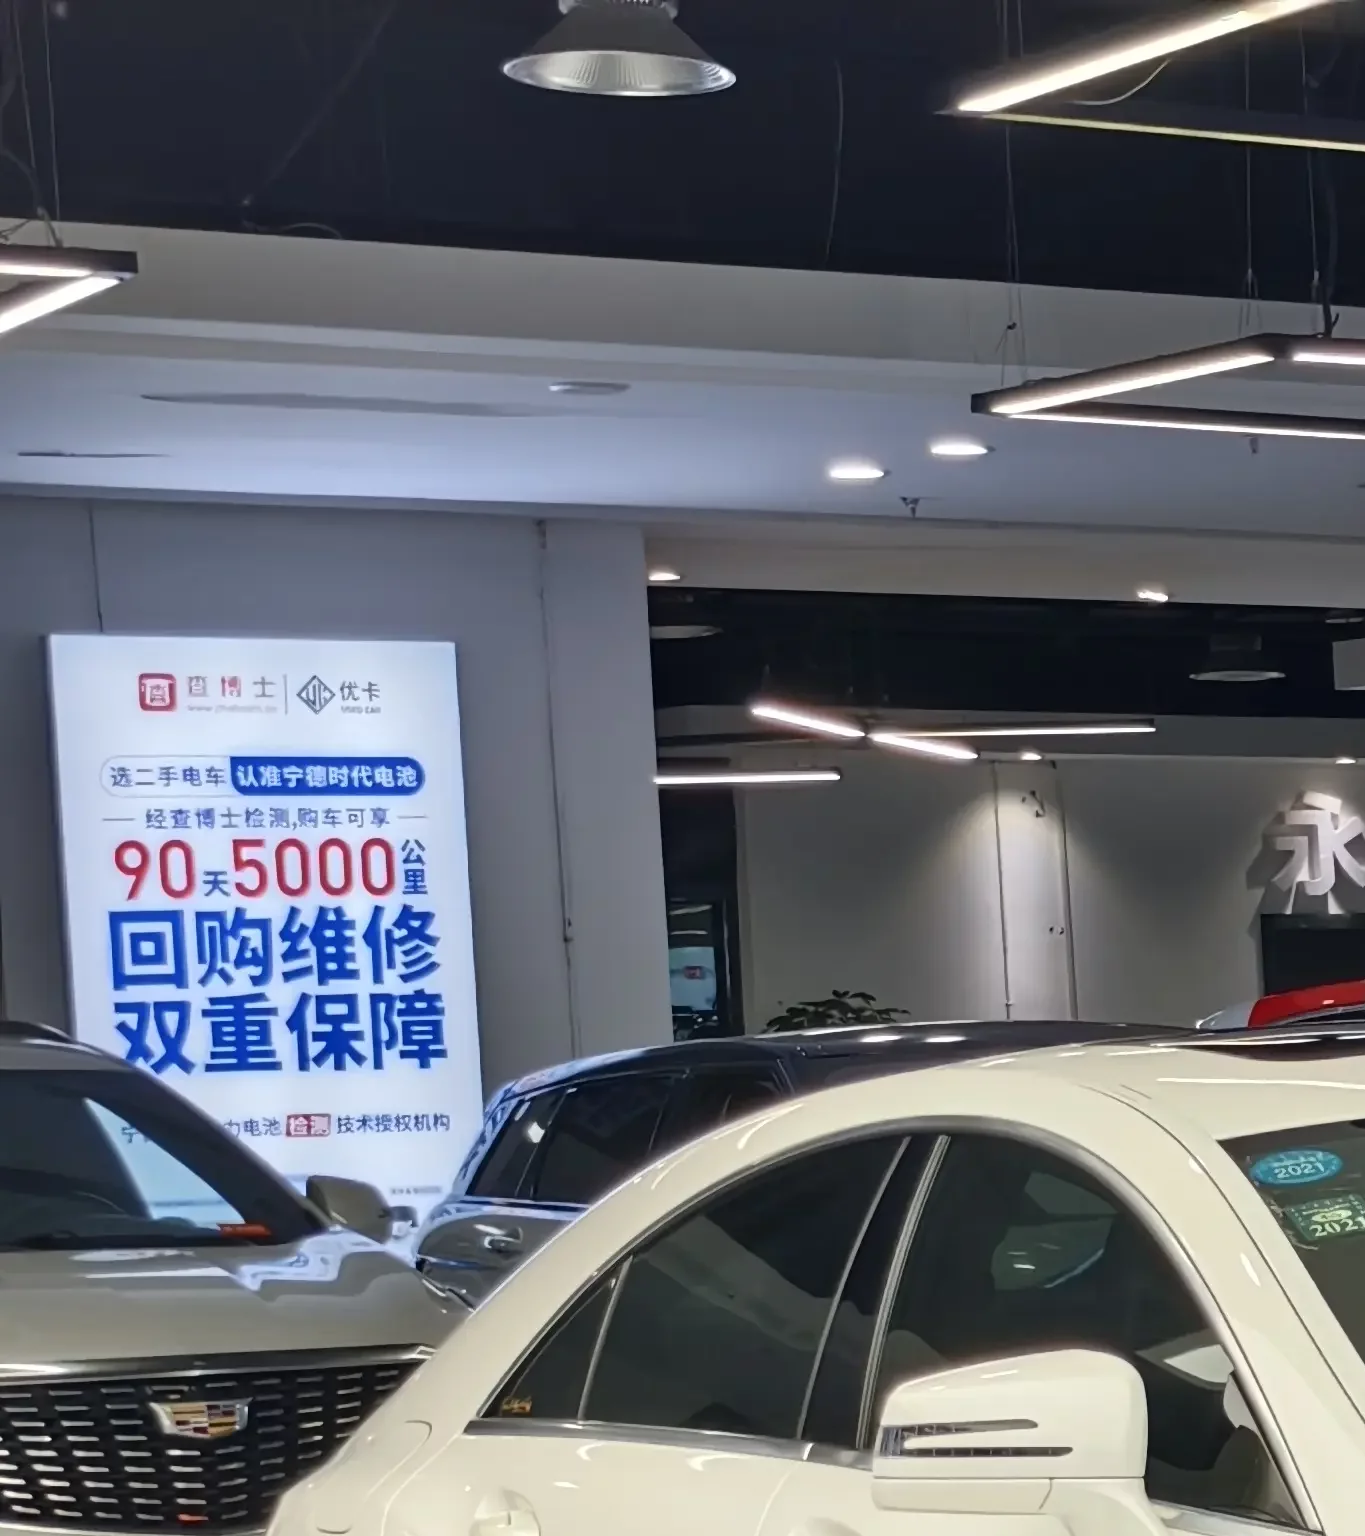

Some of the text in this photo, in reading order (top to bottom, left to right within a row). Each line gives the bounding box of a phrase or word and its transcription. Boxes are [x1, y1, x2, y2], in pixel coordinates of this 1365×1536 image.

[339, 680, 381, 702] 优卡
[109, 764, 226, 789] 选二手电车
[236, 764, 419, 790] 认准宁德时代电池
[107, 902, 442, 990] 回购维修
[113, 989, 448, 1076] 双重保障
[1275, 1163, 1325, 1179] 2021
